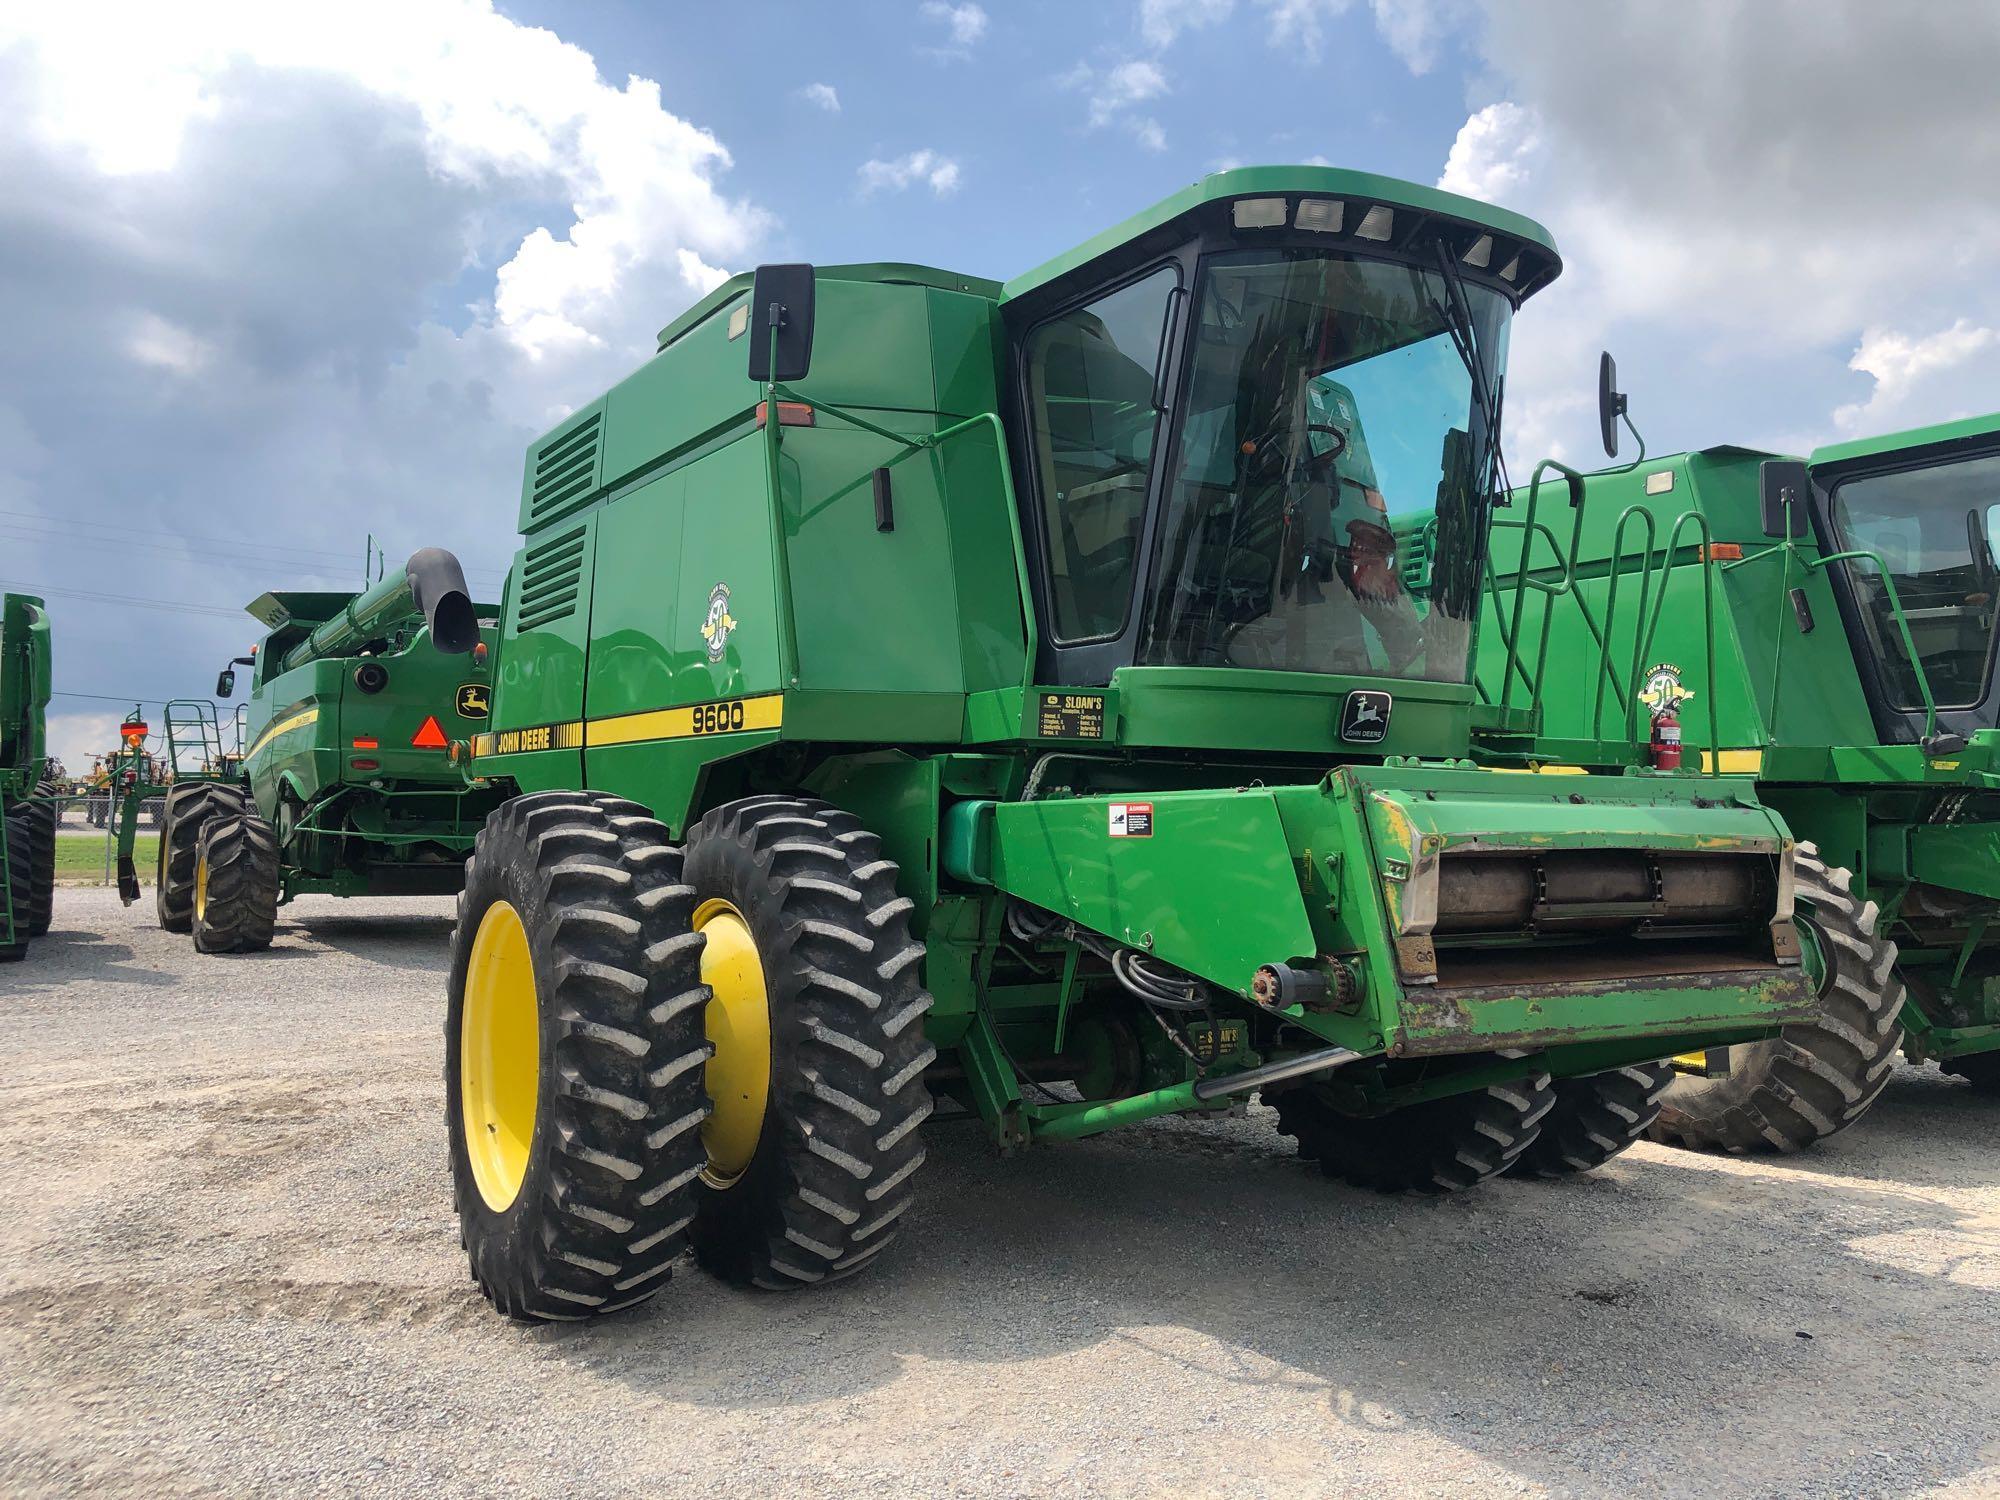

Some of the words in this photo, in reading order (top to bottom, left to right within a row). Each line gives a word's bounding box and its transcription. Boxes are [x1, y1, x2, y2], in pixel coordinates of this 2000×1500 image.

[1647, 665, 1661, 677] JOHN
[1662, 664, 1681, 675] DEERE
[1065, 696, 1102, 710] SLOAN'S
[692, 702, 744, 733] 9600
[498, 732, 520, 754] JOHN
[521, 727, 550, 750] DEERE
[1362, 730, 1382, 738] DEERE
[1207, 1029, 1237, 1044] SAN'S
